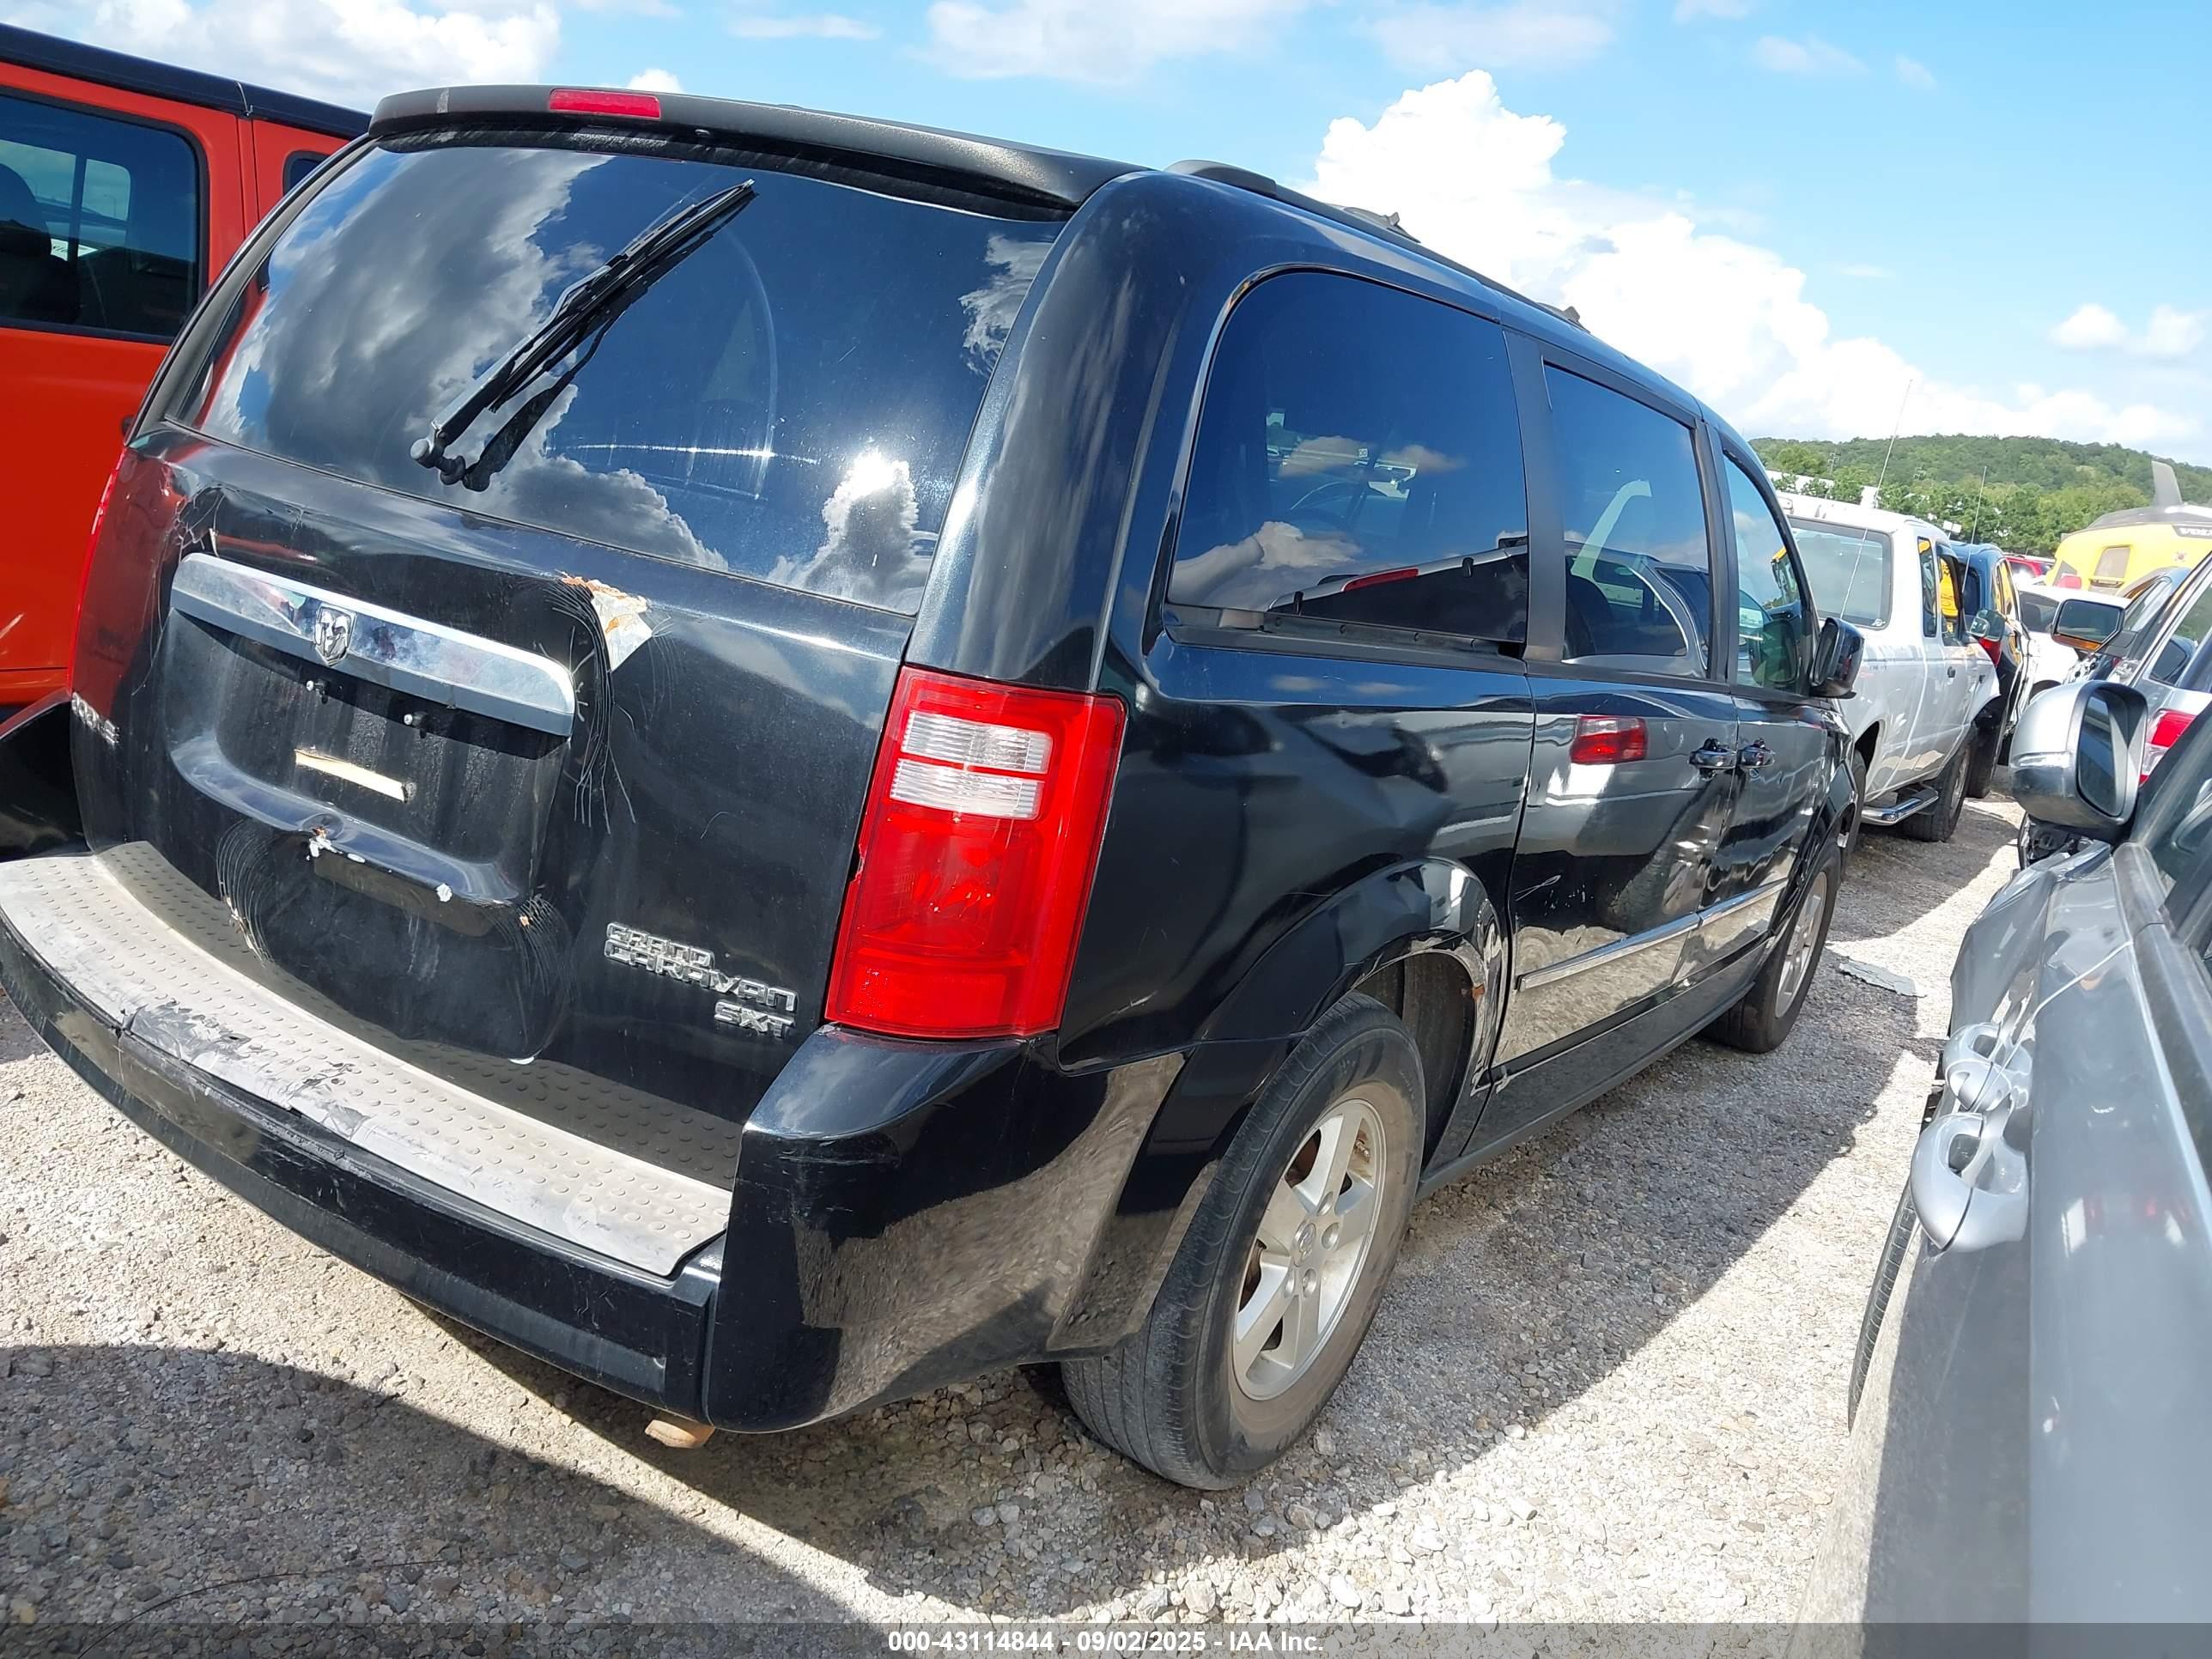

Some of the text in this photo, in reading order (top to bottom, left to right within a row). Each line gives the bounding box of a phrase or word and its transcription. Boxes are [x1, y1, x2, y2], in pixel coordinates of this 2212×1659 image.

[606, 921, 715, 969] GRAND
[604, 939, 799, 1012] CARAVAN
[714, 1000, 795, 1038] SXT
